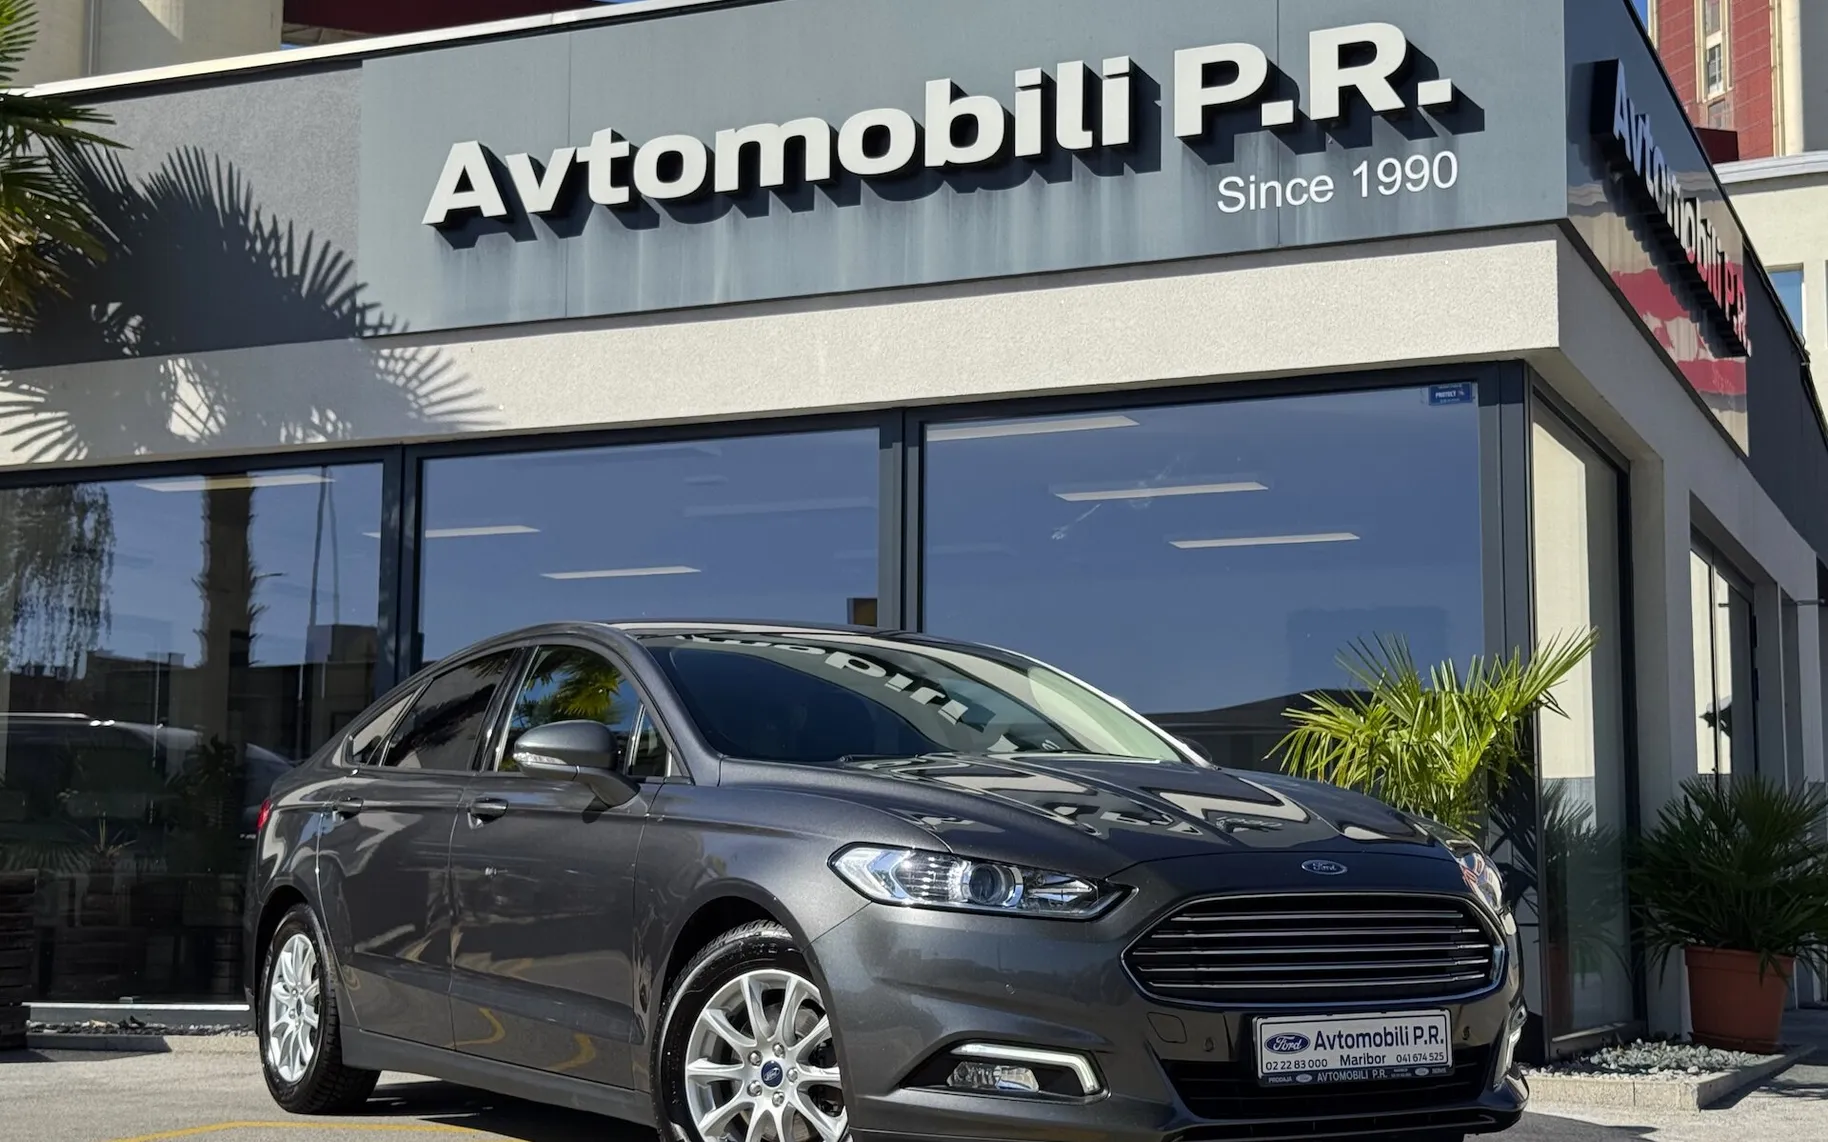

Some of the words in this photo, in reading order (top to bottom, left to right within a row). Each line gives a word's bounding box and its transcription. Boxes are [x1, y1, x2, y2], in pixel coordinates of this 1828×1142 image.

[422, 56, 1129, 225] Avtomobili
[1174, 23, 1453, 137] P.R.
[1217, 174, 1334, 213] Since
[1353, 150, 1458, 198] 1990
[1313, 1026, 1409, 1051] Avtomobili
[1413, 1025, 1444, 1046] P.R.
[1308, 1059, 1328, 1068] 000
[1339, 1053, 1386, 1067] Maribor
[1429, 1052, 1444, 1061] 525
[1317, 1069, 1369, 1082] AVTOMOBILI
[1372, 1069, 1388, 1079] P.R.
